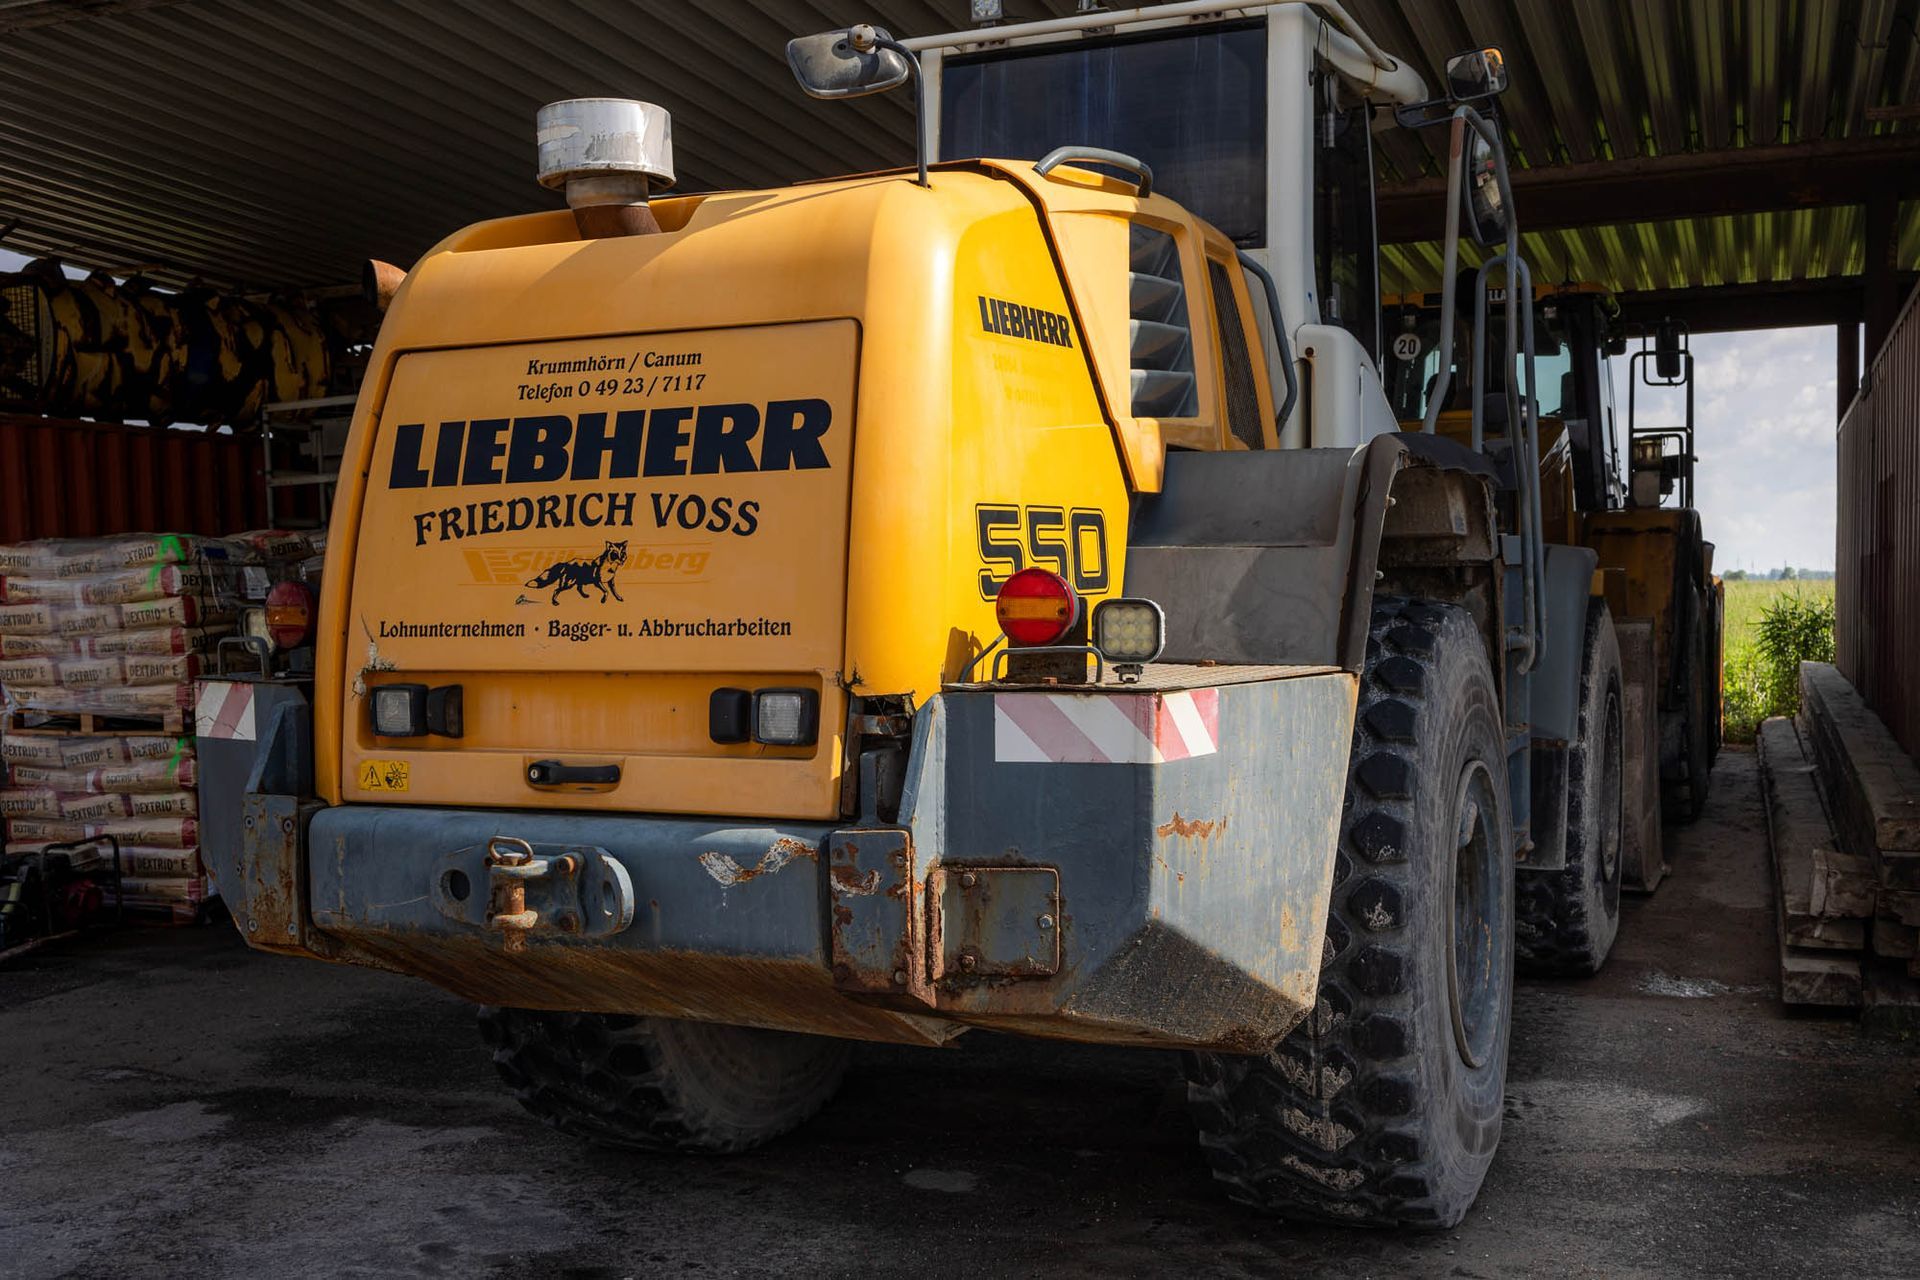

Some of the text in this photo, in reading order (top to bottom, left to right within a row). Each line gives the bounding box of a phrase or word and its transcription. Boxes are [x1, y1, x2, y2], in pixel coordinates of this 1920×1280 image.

[978, 296, 1073, 349] LIEBHERR
[1398, 338, 1416, 355] 20
[526, 352, 626, 377] Krummhörn
[643, 351, 703, 370] Canum
[517, 382, 574, 403] Telefon
[595, 378, 617, 397] 49
[621, 377, 645, 396] 23
[663, 373, 706, 394] 7117
[388, 397, 833, 490] LIEBHERR
[414, 492, 761, 547] FRIEDRICH VOSS
[975, 503, 1109, 602] 550
[38, 612, 43, 625] E
[168, 606, 175, 618] E
[379, 620, 526, 638] Lohnunternehmen
[547, 620, 612, 642] Bagger-
[617, 623, 634, 637] u.
[638, 618, 792, 637] Abbrucharbeiten
[172, 664, 179, 676] E
[106, 747, 113, 759] E
[43, 799, 49, 811] E
[108, 801, 115, 813] E
[179, 798, 186, 810] E
[181, 858, 187, 870] E
